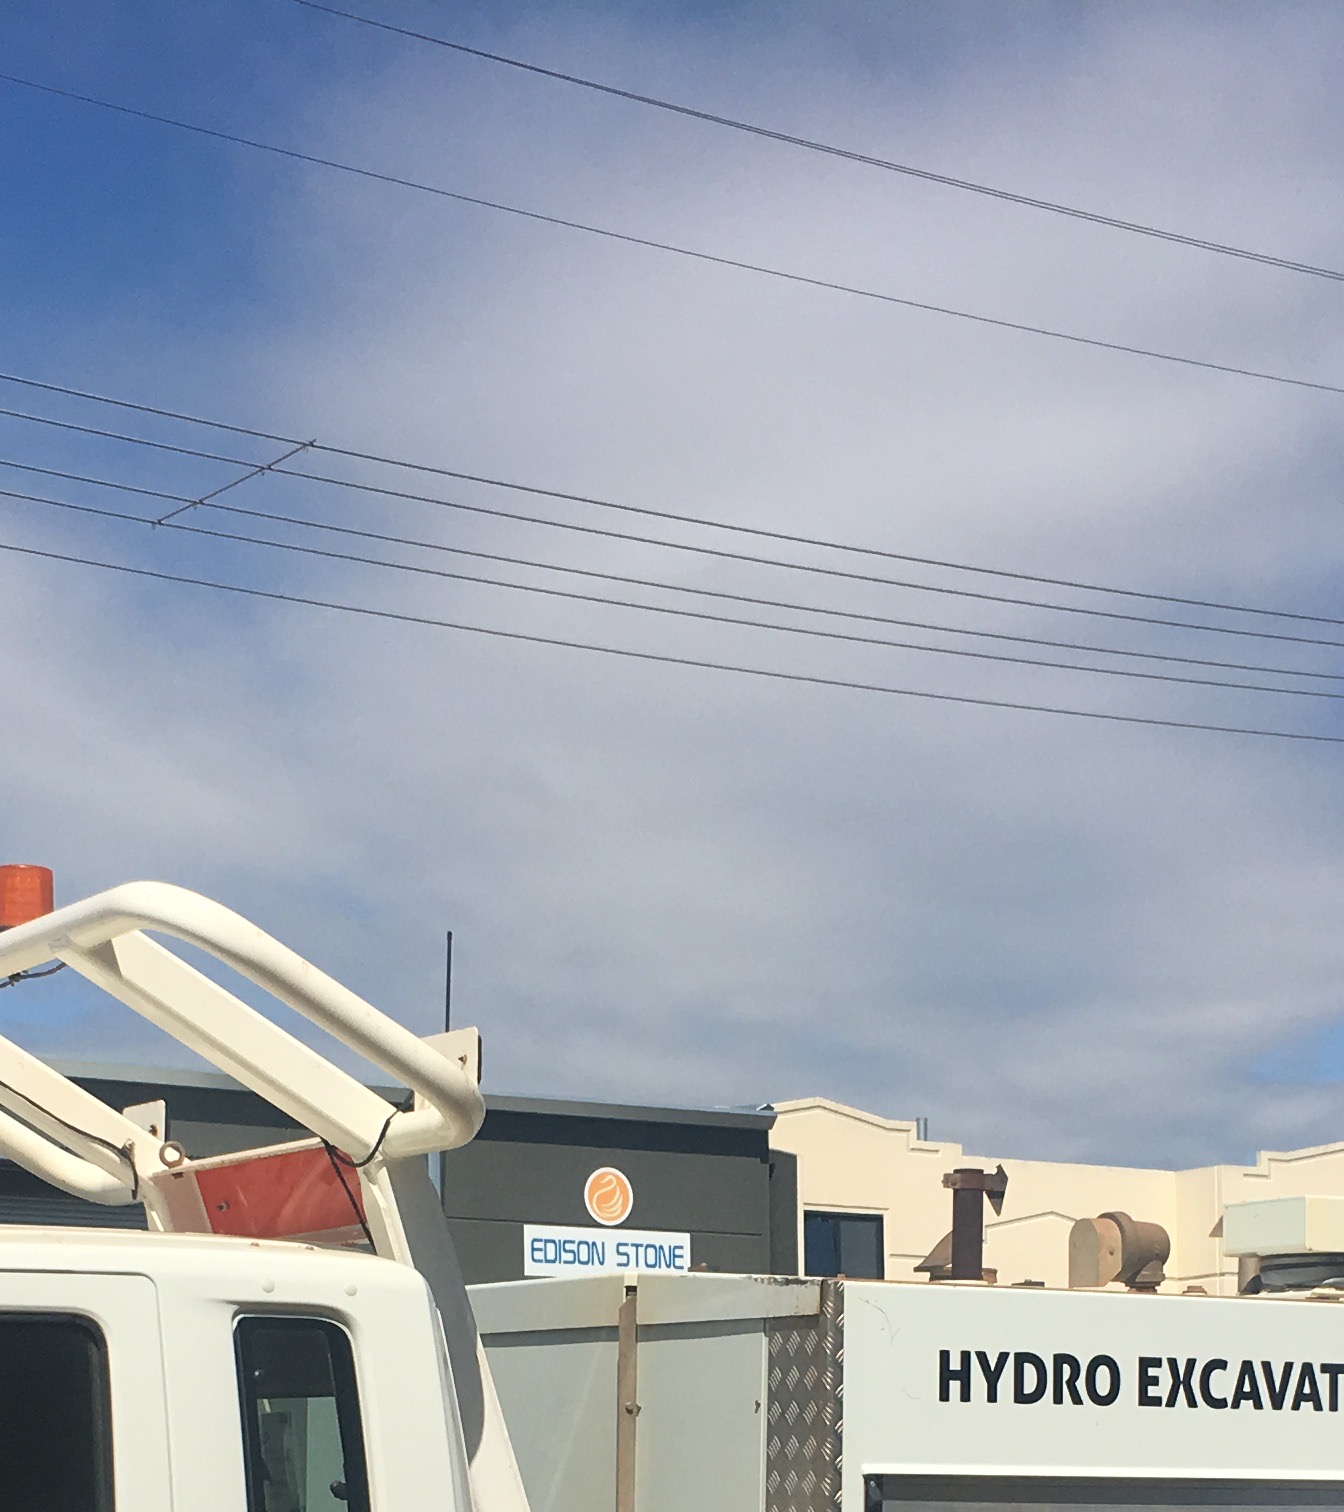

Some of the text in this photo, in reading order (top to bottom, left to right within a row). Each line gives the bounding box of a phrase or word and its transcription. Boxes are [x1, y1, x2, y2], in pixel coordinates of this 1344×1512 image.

[531, 1238, 684, 1270] EDISON STONE
[939, 1349, 1122, 1406] HYDRO
